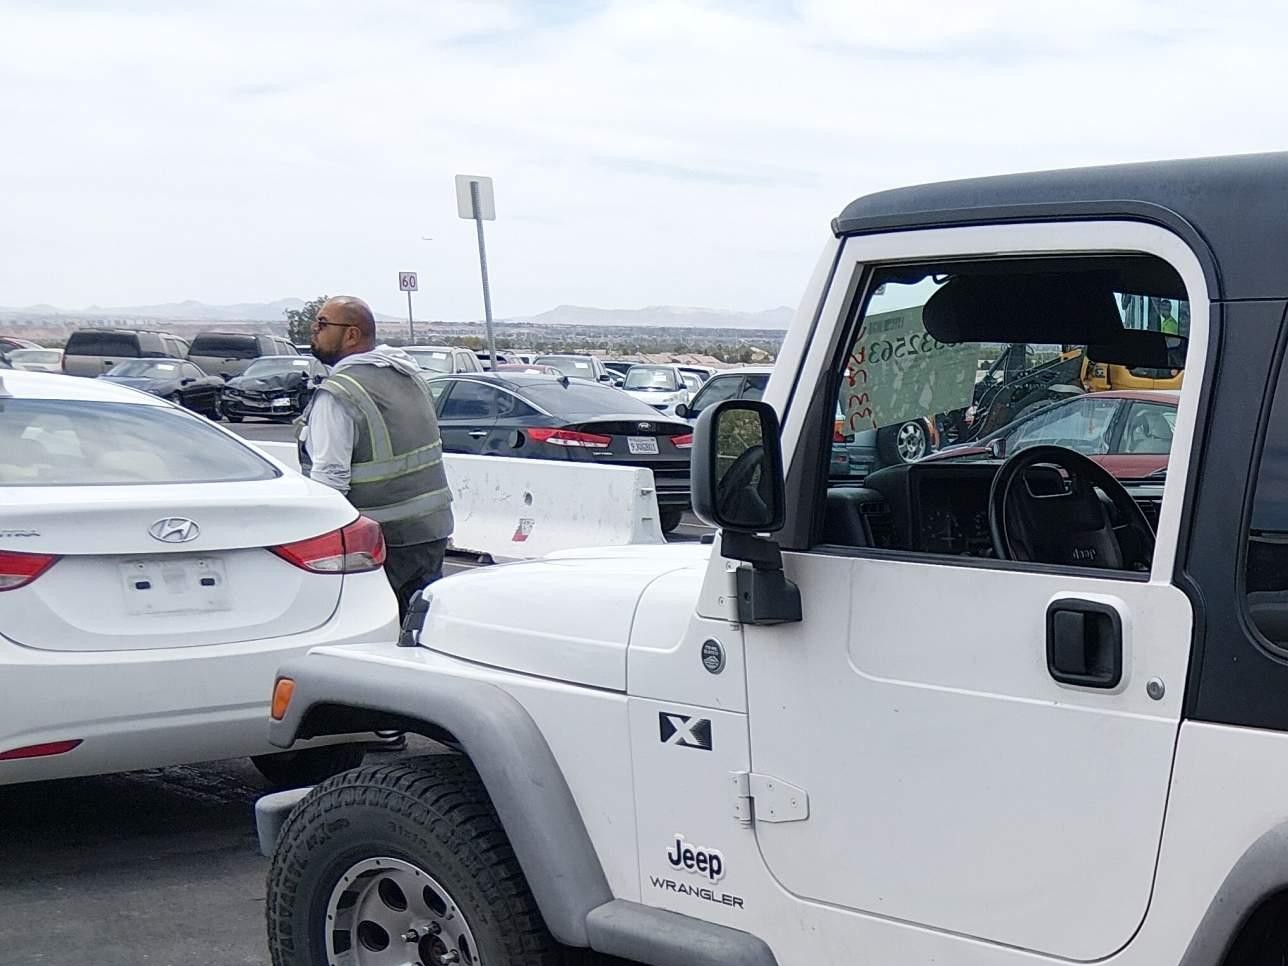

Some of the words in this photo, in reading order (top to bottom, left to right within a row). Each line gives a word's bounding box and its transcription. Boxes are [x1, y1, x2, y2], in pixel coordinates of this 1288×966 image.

[402, 275, 416, 288] 60
[661, 713, 708, 749] X
[668, 839, 722, 879] Jeep
[650, 875, 744, 909] WRANGLER
